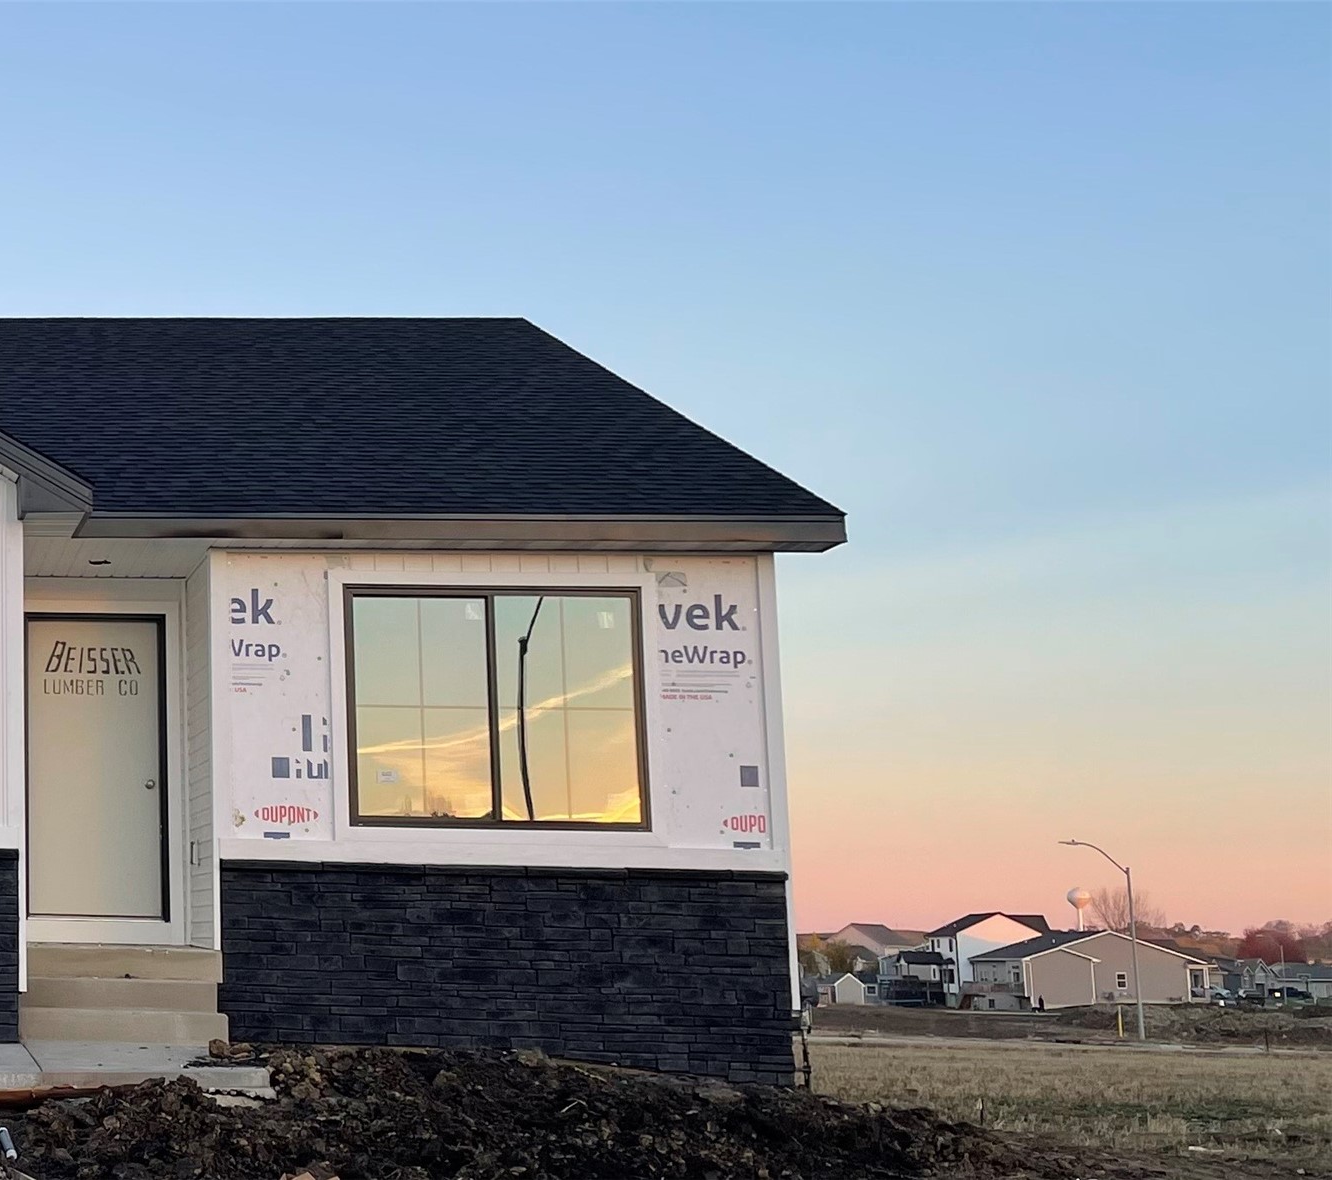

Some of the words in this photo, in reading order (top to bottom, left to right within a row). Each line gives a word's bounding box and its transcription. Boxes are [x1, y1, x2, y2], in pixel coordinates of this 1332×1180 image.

[45, 640, 141, 675] BEISSER
[43, 679, 105, 696] LUMBER
[118, 679, 139, 696] CO
[261, 805, 312, 823] DUPONT
